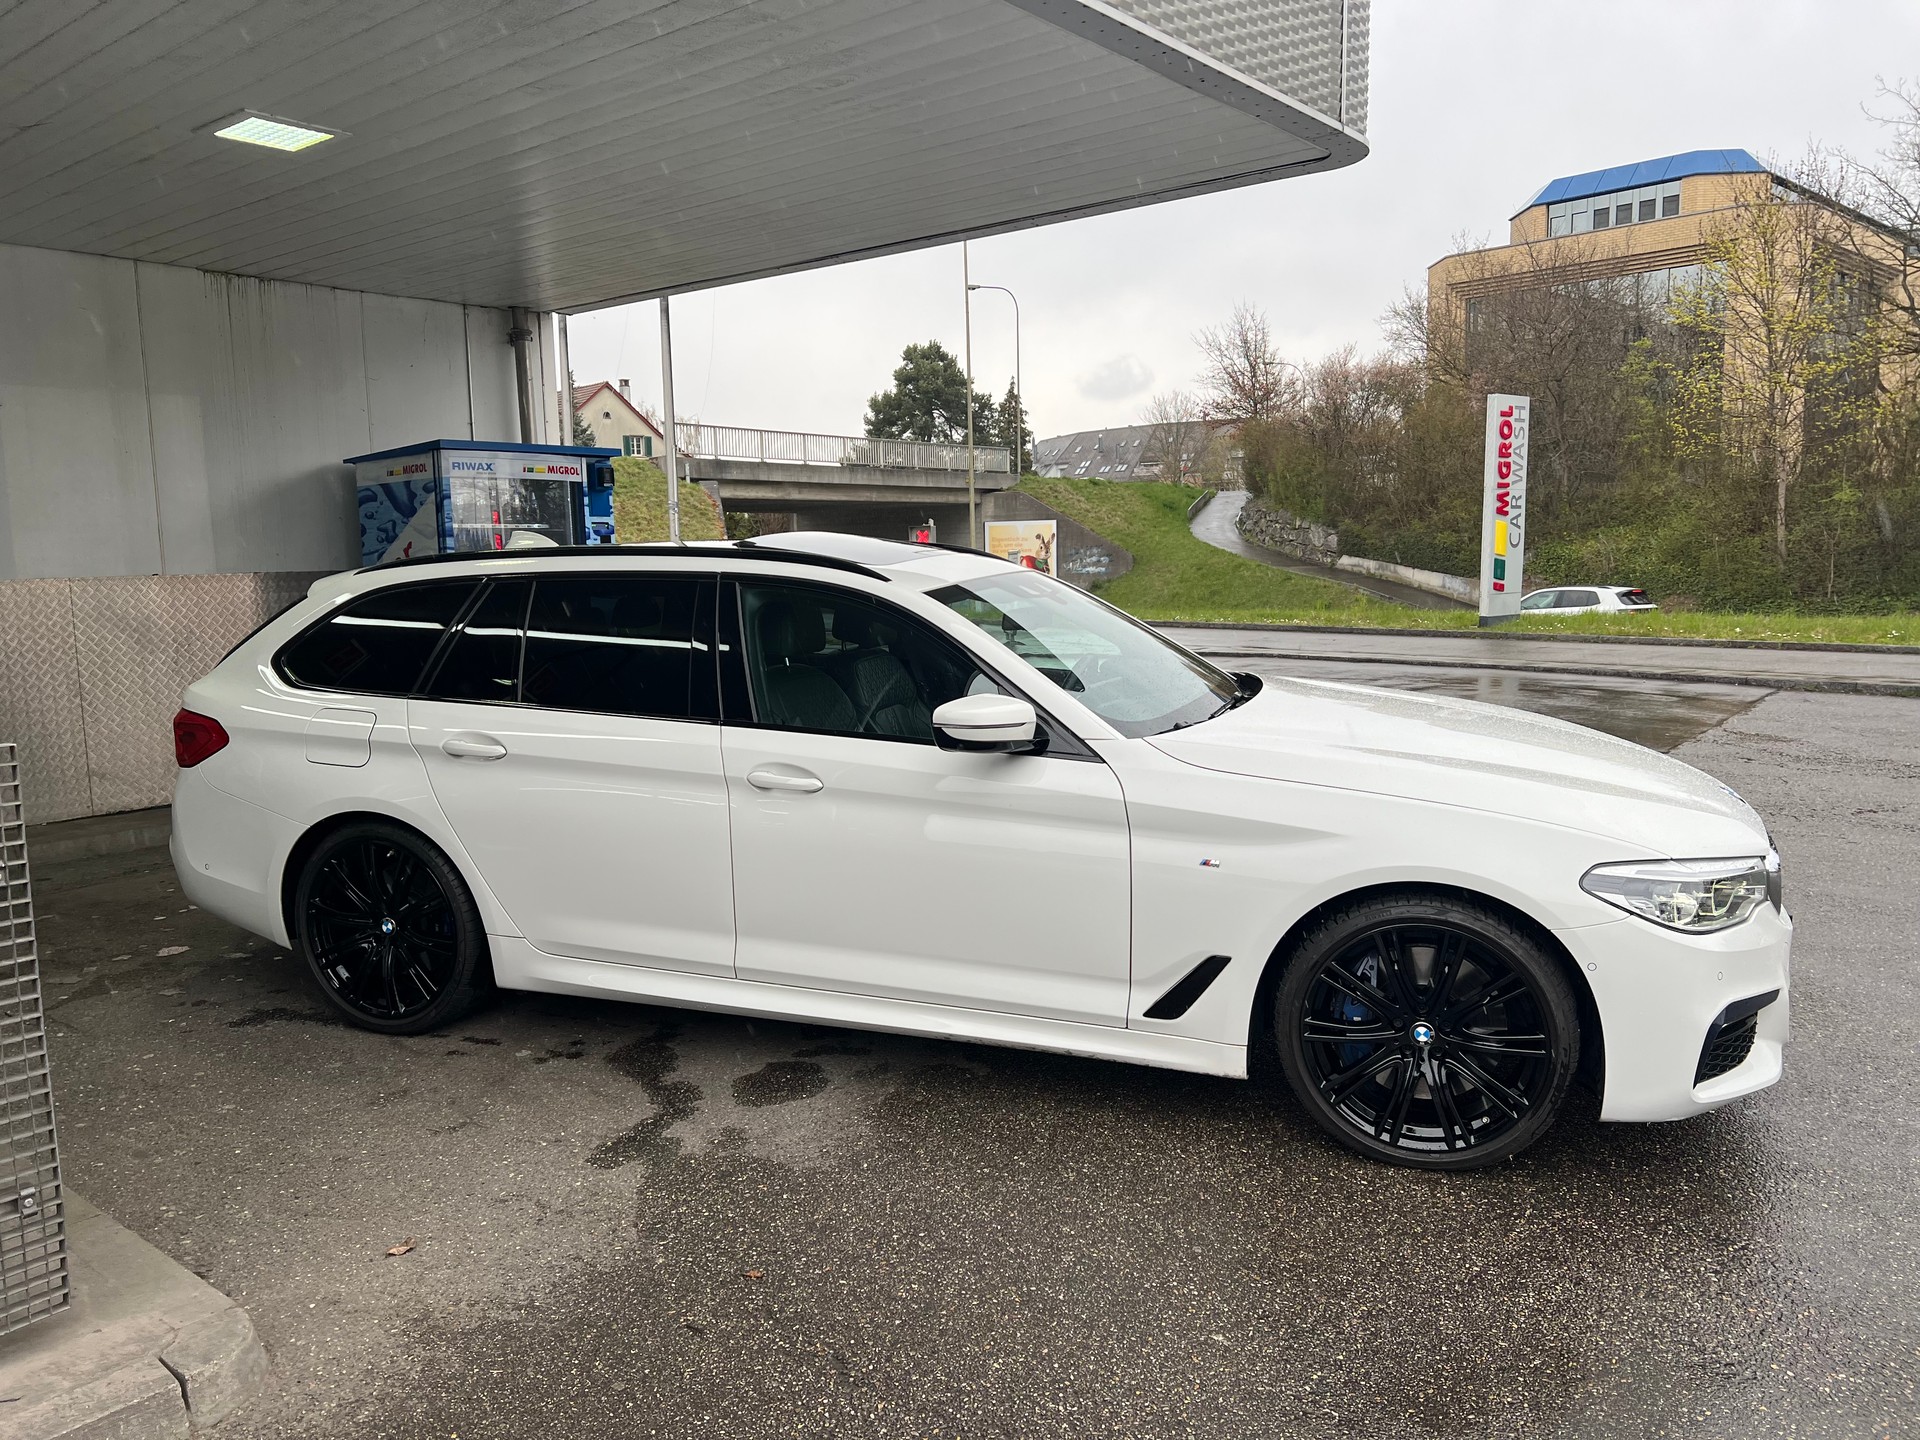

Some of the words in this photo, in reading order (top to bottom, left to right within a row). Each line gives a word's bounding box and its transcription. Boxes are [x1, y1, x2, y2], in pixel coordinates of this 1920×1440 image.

[1495, 405, 1514, 517] MIGROL
[1511, 405, 1526, 486] WASH
[402, 463, 427, 474] MIGROL
[452, 461, 494, 471] RIWAX
[547, 465, 580, 476] MIGROL
[1509, 494, 1523, 549] CAR
